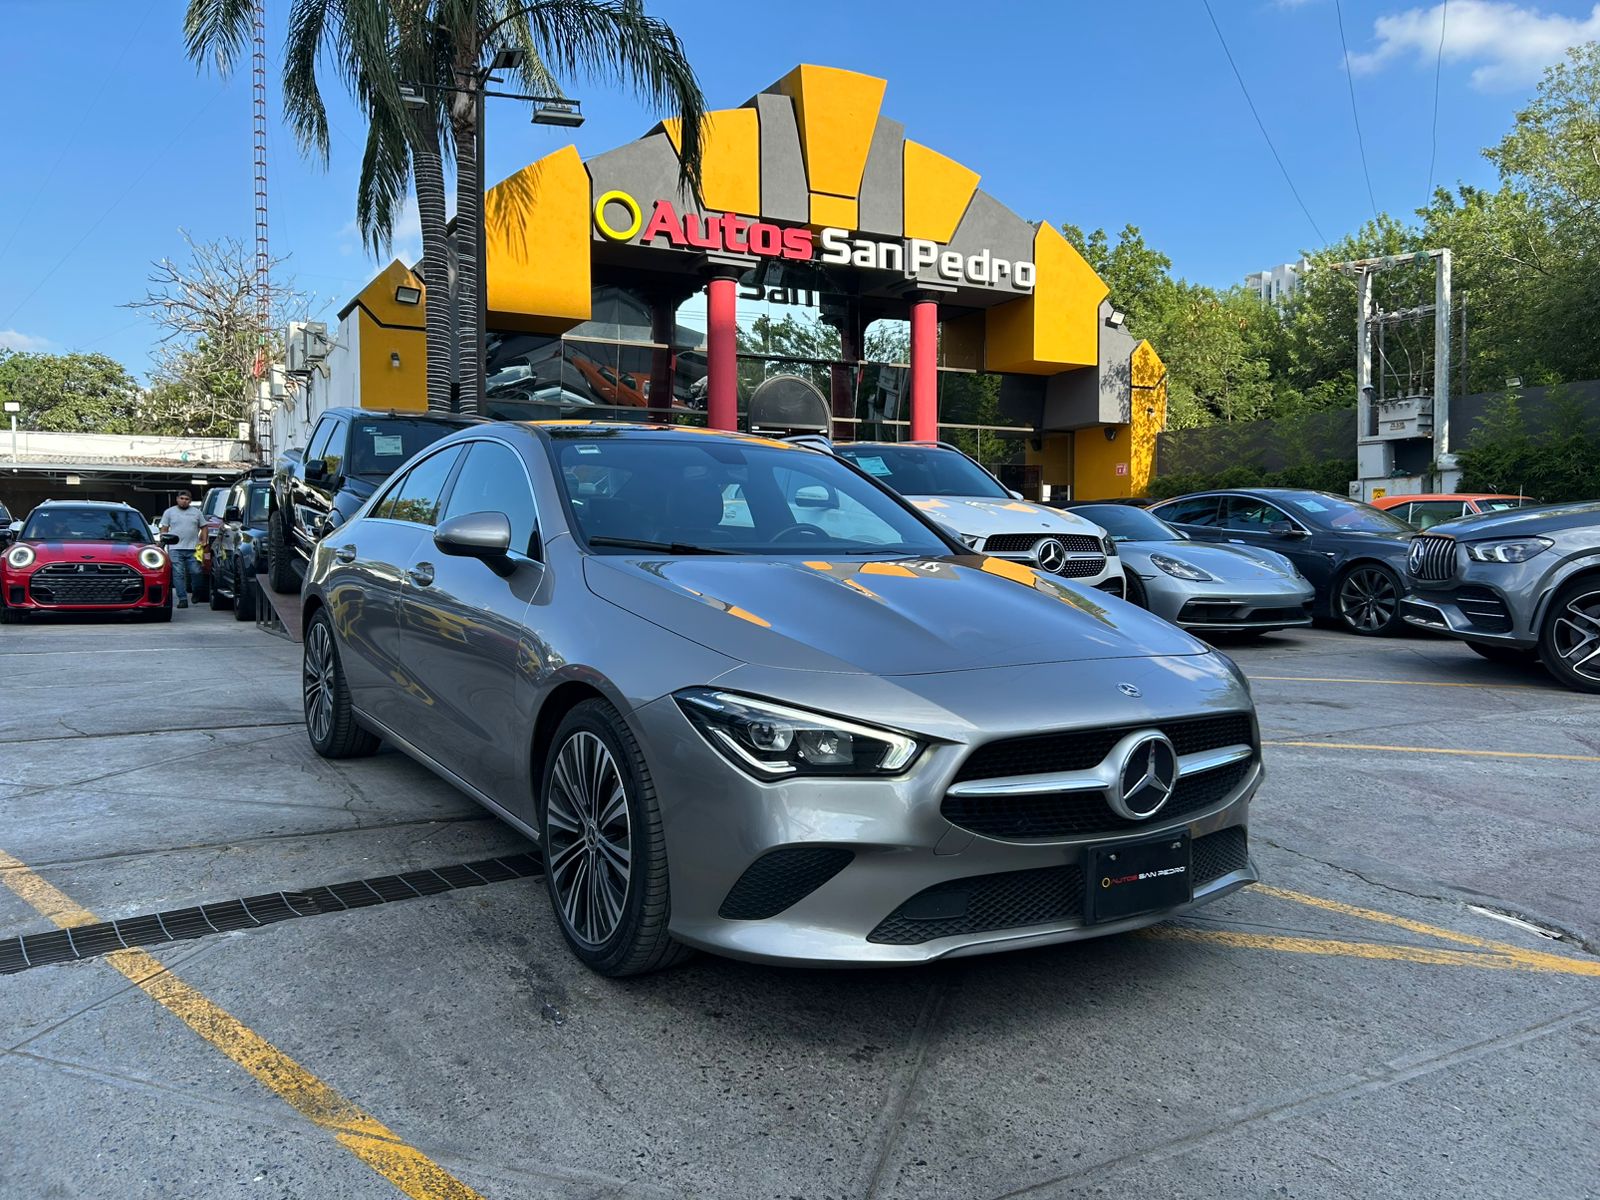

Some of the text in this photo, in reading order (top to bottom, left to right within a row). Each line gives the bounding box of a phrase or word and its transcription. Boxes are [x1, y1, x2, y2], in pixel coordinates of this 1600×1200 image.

[643, 200, 813, 260] Autos
[1111, 866, 1186, 884] AUTOS SAN PEDRO
